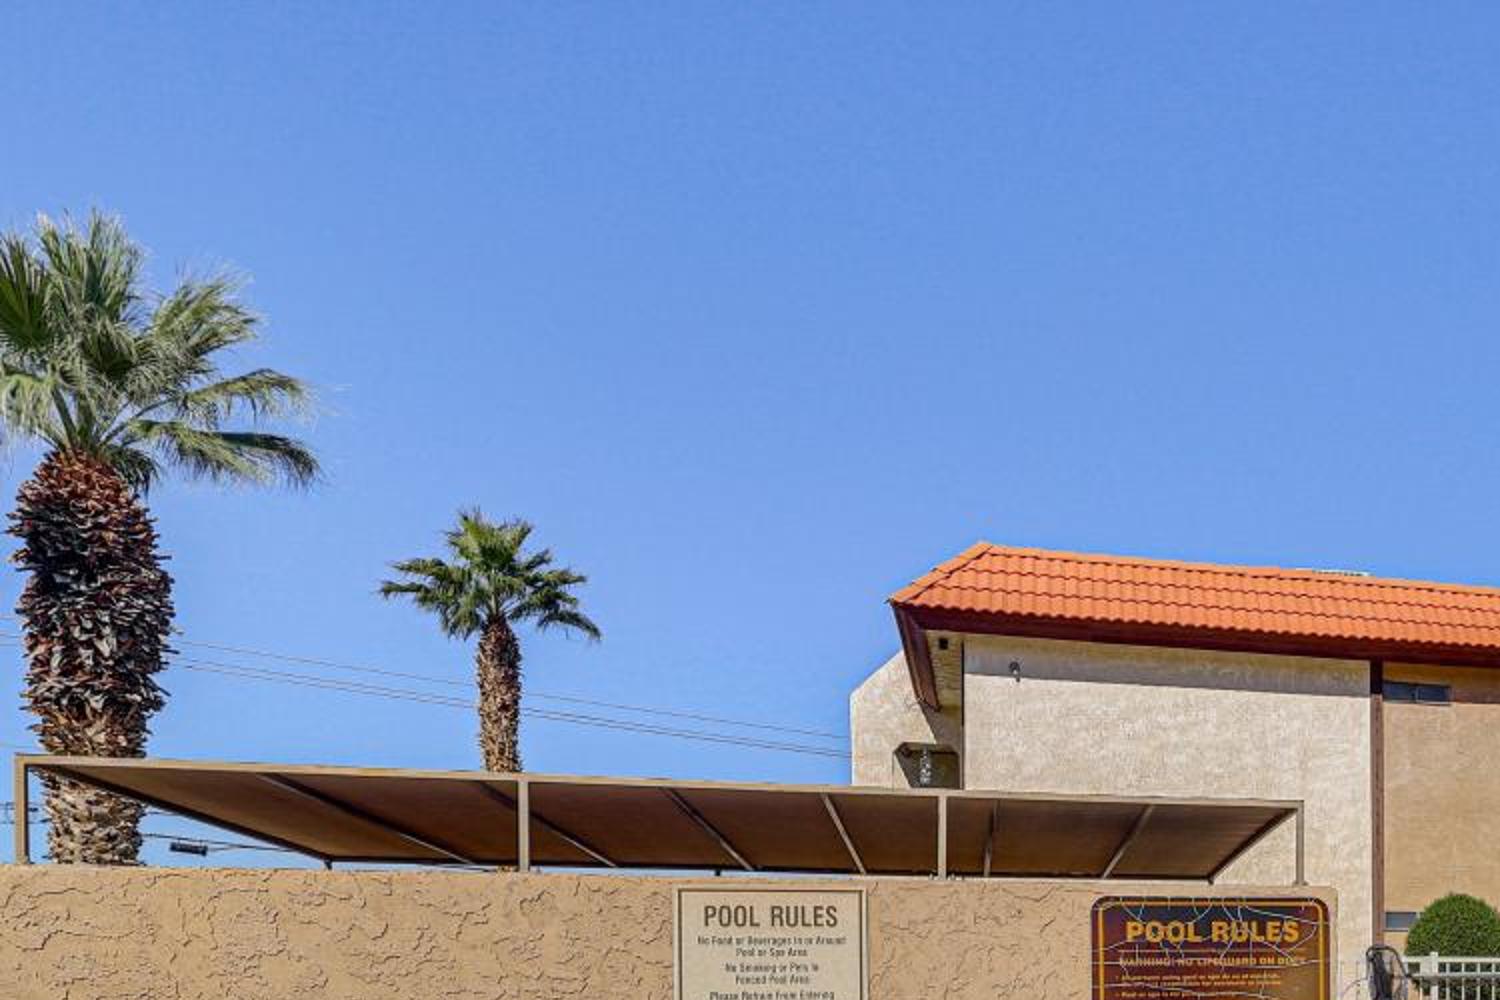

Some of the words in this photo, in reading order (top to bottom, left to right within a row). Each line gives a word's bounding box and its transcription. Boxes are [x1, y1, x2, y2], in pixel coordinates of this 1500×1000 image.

[704, 905, 761, 928] POOL
[770, 905, 838, 928] RULES
[1125, 920, 1202, 942] POOL
[1210, 919, 1300, 942] RULES
[711, 936, 733, 945] Food
[735, 937, 744, 945] or
[747, 936, 792, 947] Beverages
[815, 936, 847, 945] Around
[736, 947, 755, 956] Pool
[769, 947, 785, 959] Spa
[1259, 957, 1274, 965] ON
[725, 963, 737, 972] No
[739, 963, 777, 973] Smoking
[779, 964, 787, 972] or
[789, 962, 809, 972] Pets
[735, 975, 767, 984] Fenced
[769, 975, 787, 984] Pool
[709, 991, 739, 1000] Please
[741, 991, 773, 1000] Refrain
[799, 991, 834, 1000] Entering
